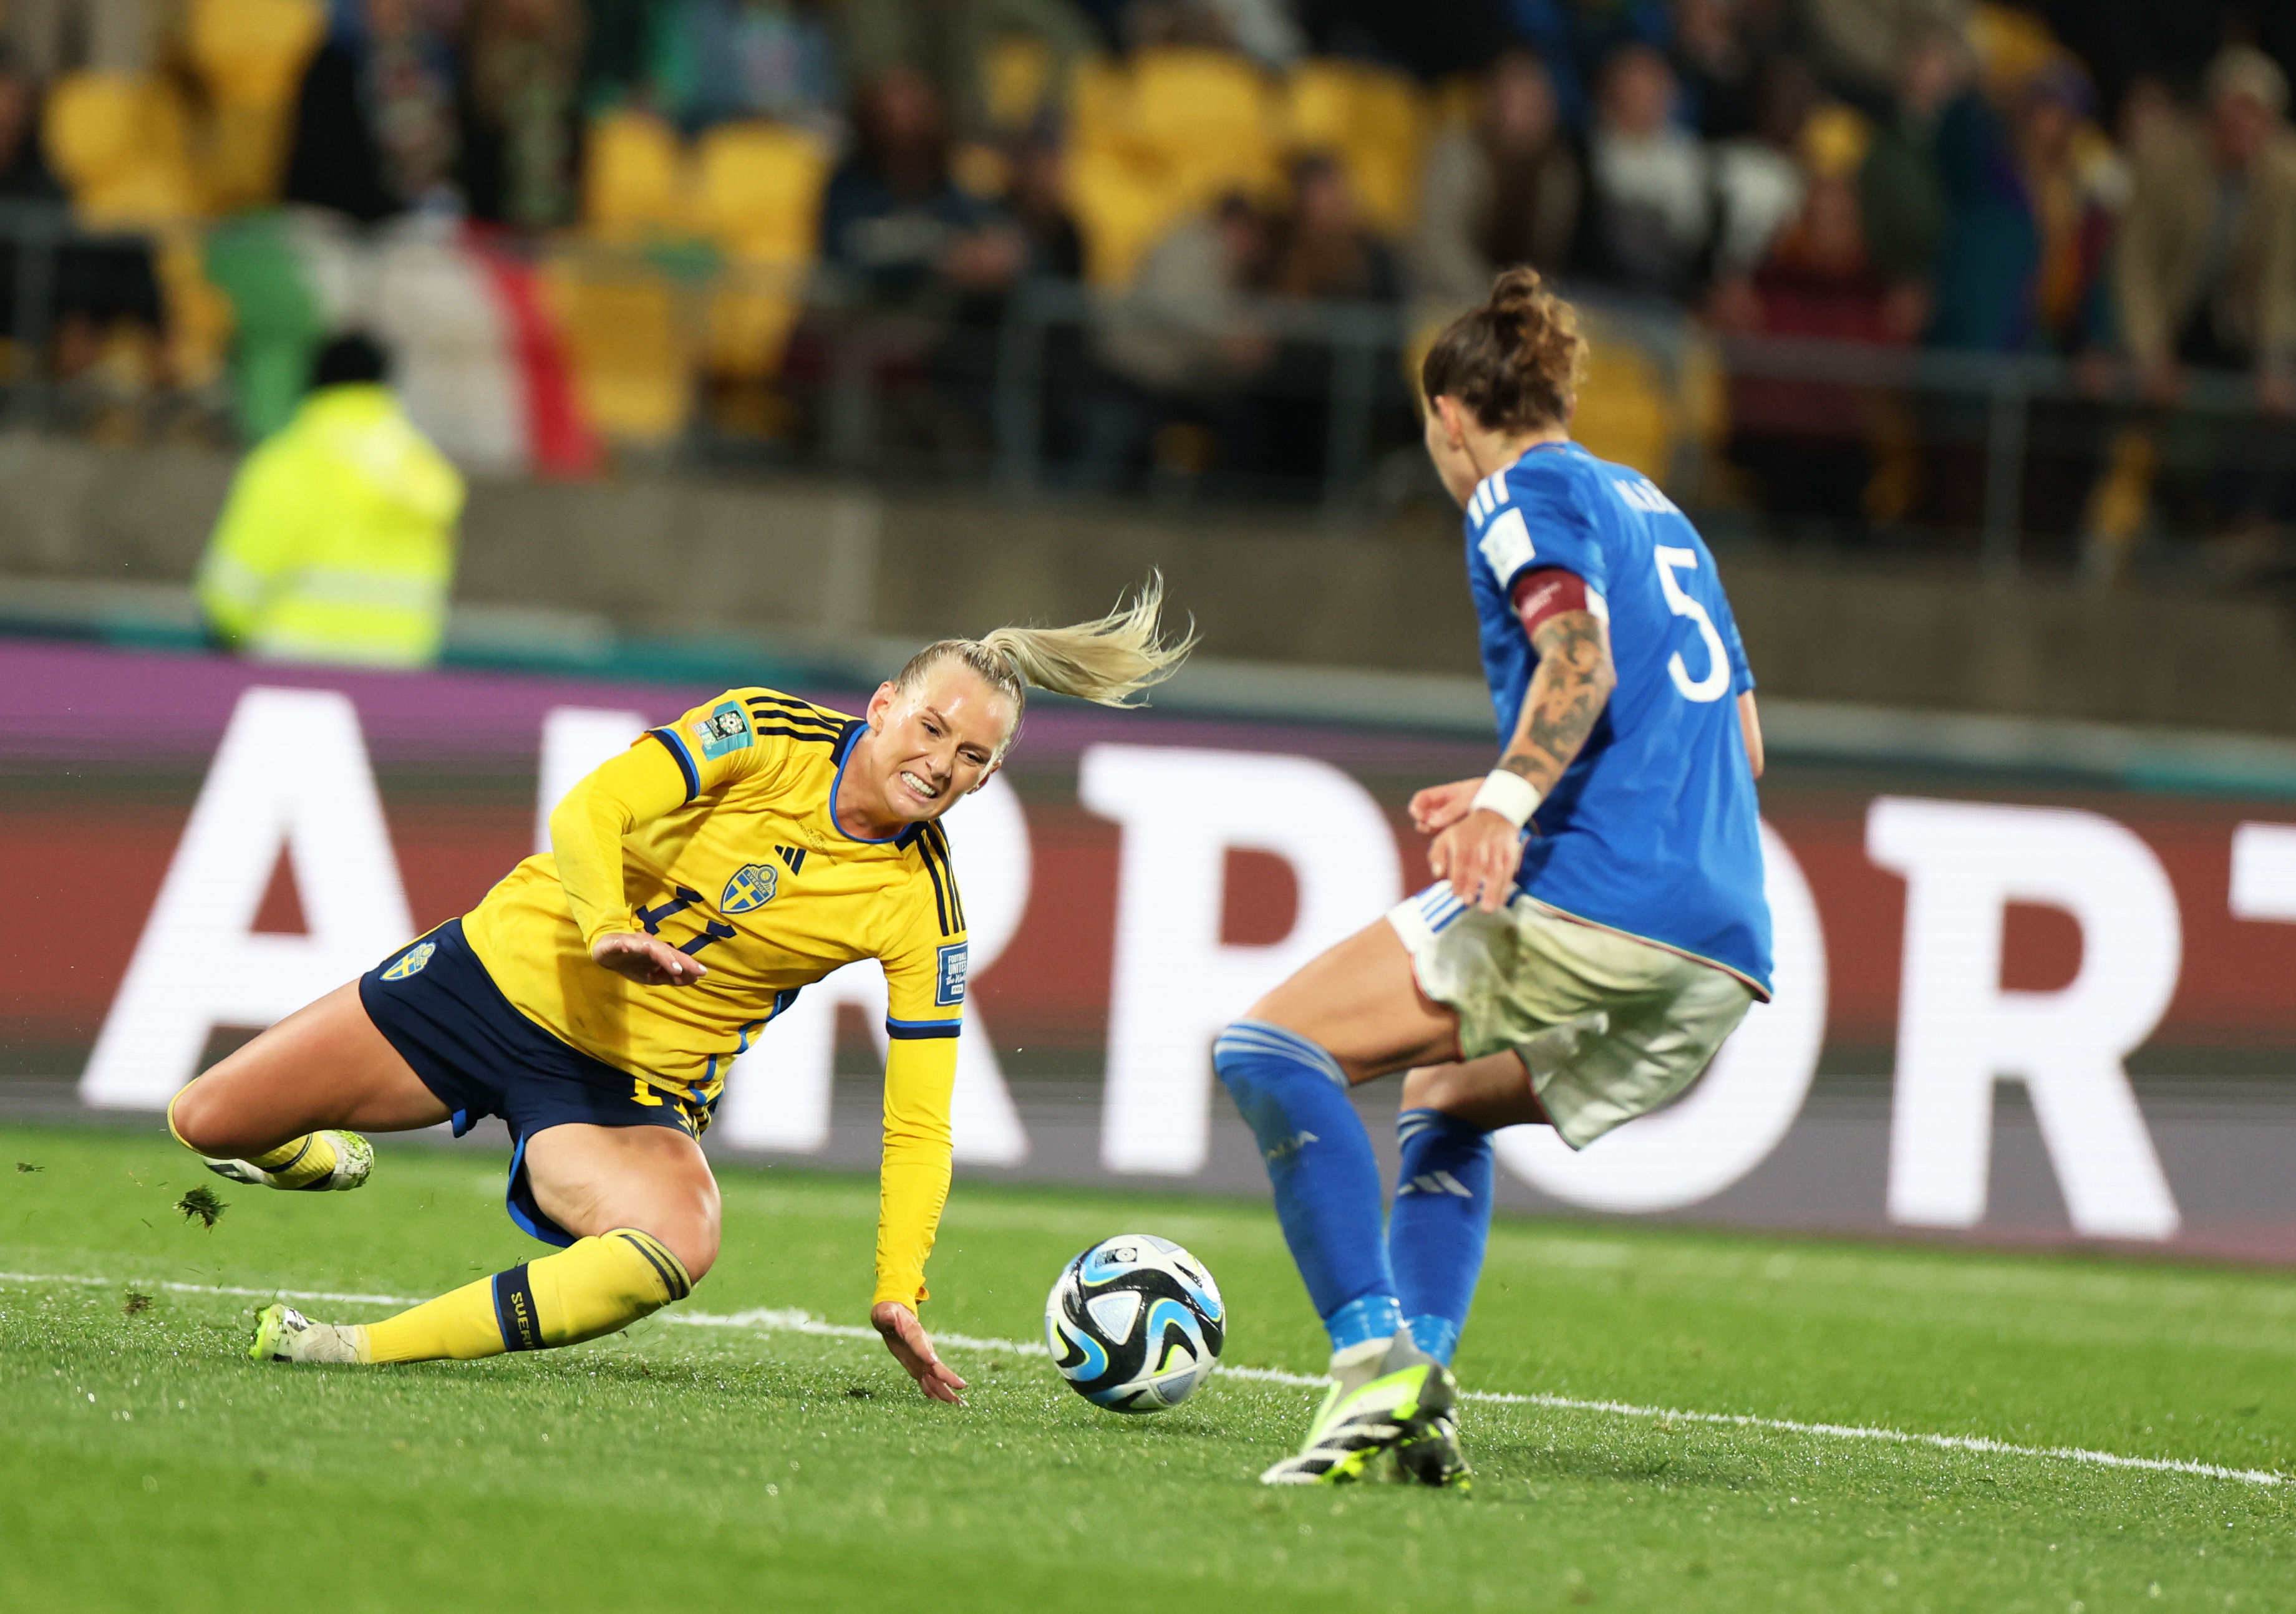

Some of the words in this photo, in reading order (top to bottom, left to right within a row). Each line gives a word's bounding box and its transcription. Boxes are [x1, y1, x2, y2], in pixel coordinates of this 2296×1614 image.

[1654, 544, 1730, 702] 5
[636, 886, 737, 956] 11
[746, 871, 768, 894] SVERIGE
[78, 685, 2296, 1239] ARPOR
